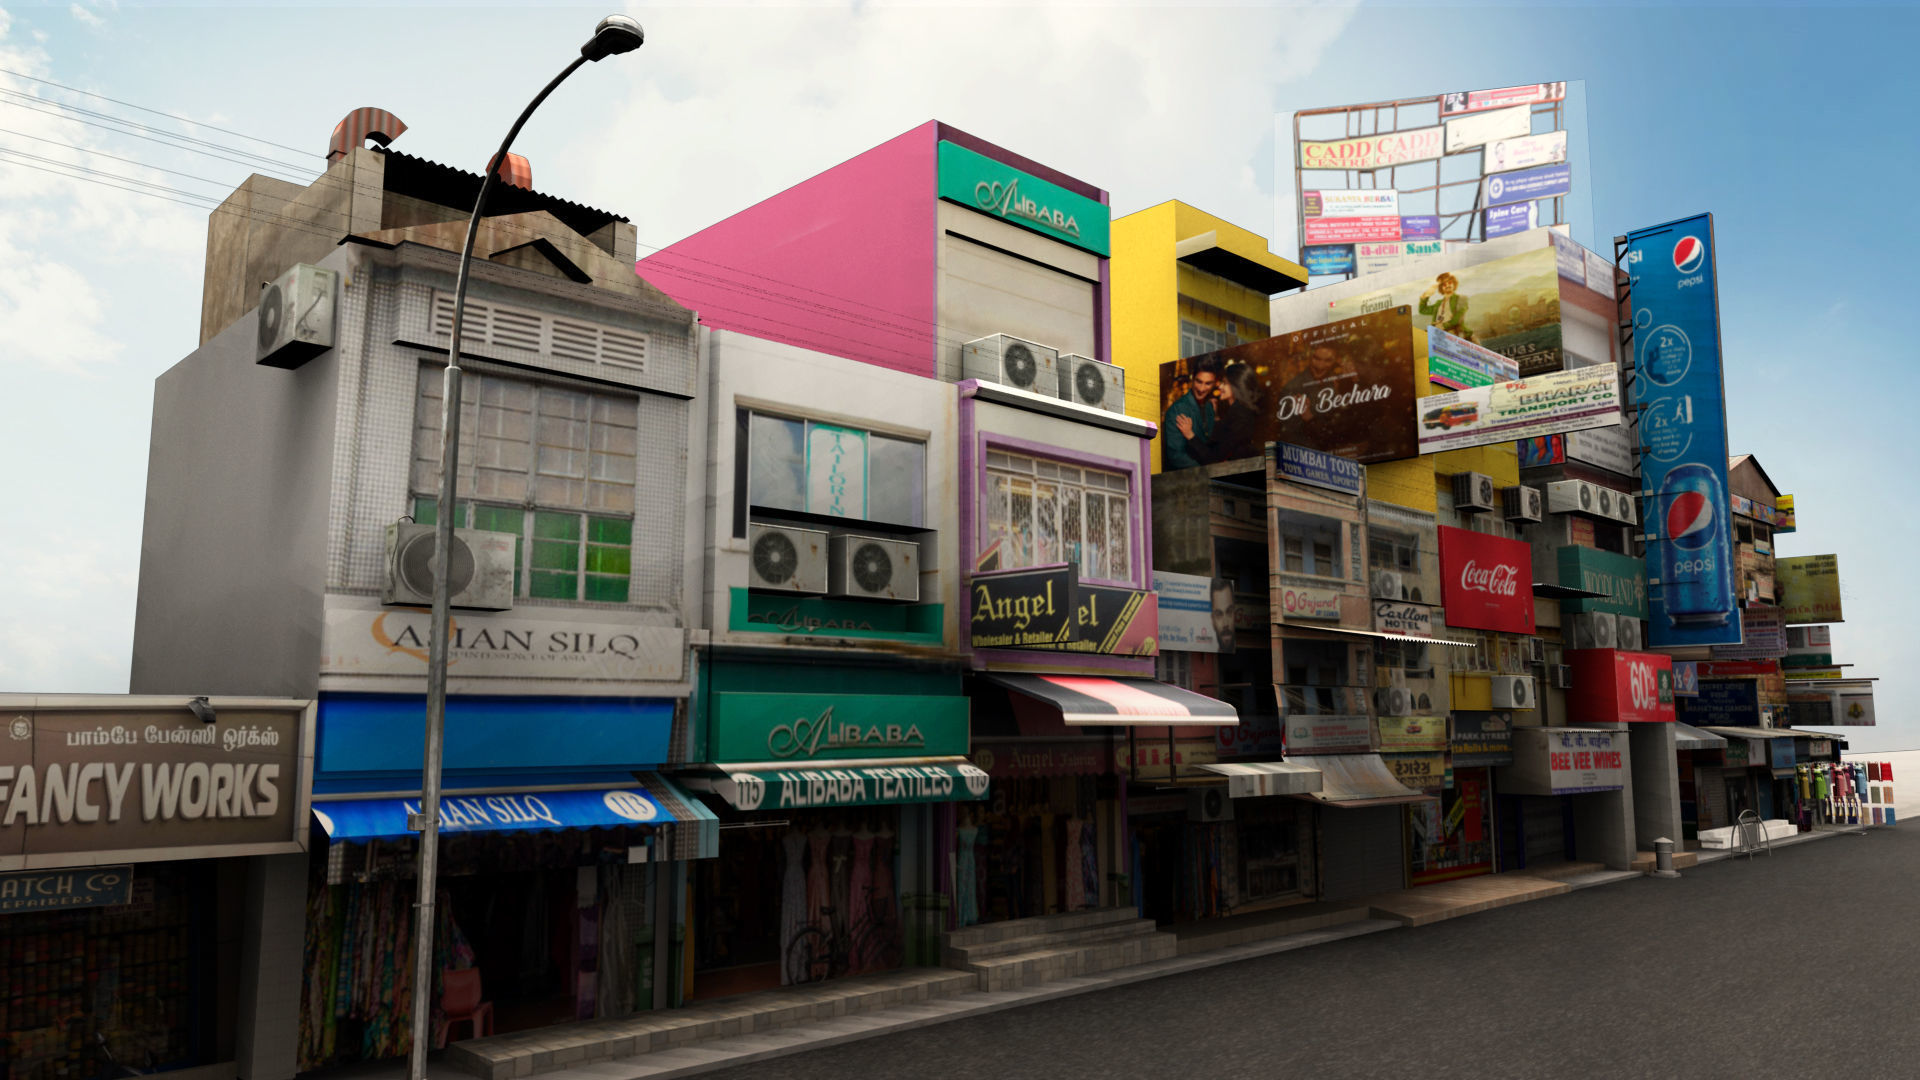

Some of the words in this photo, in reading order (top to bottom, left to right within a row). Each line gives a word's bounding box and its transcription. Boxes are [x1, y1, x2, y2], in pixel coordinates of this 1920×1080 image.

[1306, 141, 1372, 158] CADD
[1377, 131, 1440, 154] CADD
[1306, 158, 1370, 168] CENTRE
[1678, 275, 1703, 290] pepsi
[1292, 319, 1368, 344] OFFICIAL
[1276, 395, 1308, 421] Dil
[1315, 383, 1392, 414] Bechara
[1498, 397, 1588, 416] TRANSPORT
[1591, 392, 1617, 401] CO.
[1282, 445, 1327, 470] MUMBAI
[1329, 456, 1359, 479] TOYS
[1461, 559, 1519, 597] Coca-Cola
[1674, 555, 1716, 577] pepsi
[971, 578, 1057, 630] Angel
[1385, 618, 1420, 631] HOTEL
[391, 624, 534, 651] AIAN
[548, 631, 641, 661] SILQ
[1014, 633, 1021, 645] &
[66, 726, 138, 746] பாம்பே
[1551, 752, 1571, 771] BEE
[1572, 752, 1592, 771] VEE
[142, 761, 280, 822] WORKS
[777, 769, 867, 809] ALIBABA
[865, 766, 954, 802] TEXTILES
[485, 794, 562, 826] SILQ
[608, 794, 649, 817] 113
[1, 874, 74, 898] ATCH
[2, 895, 94, 910] EPAIRERS
